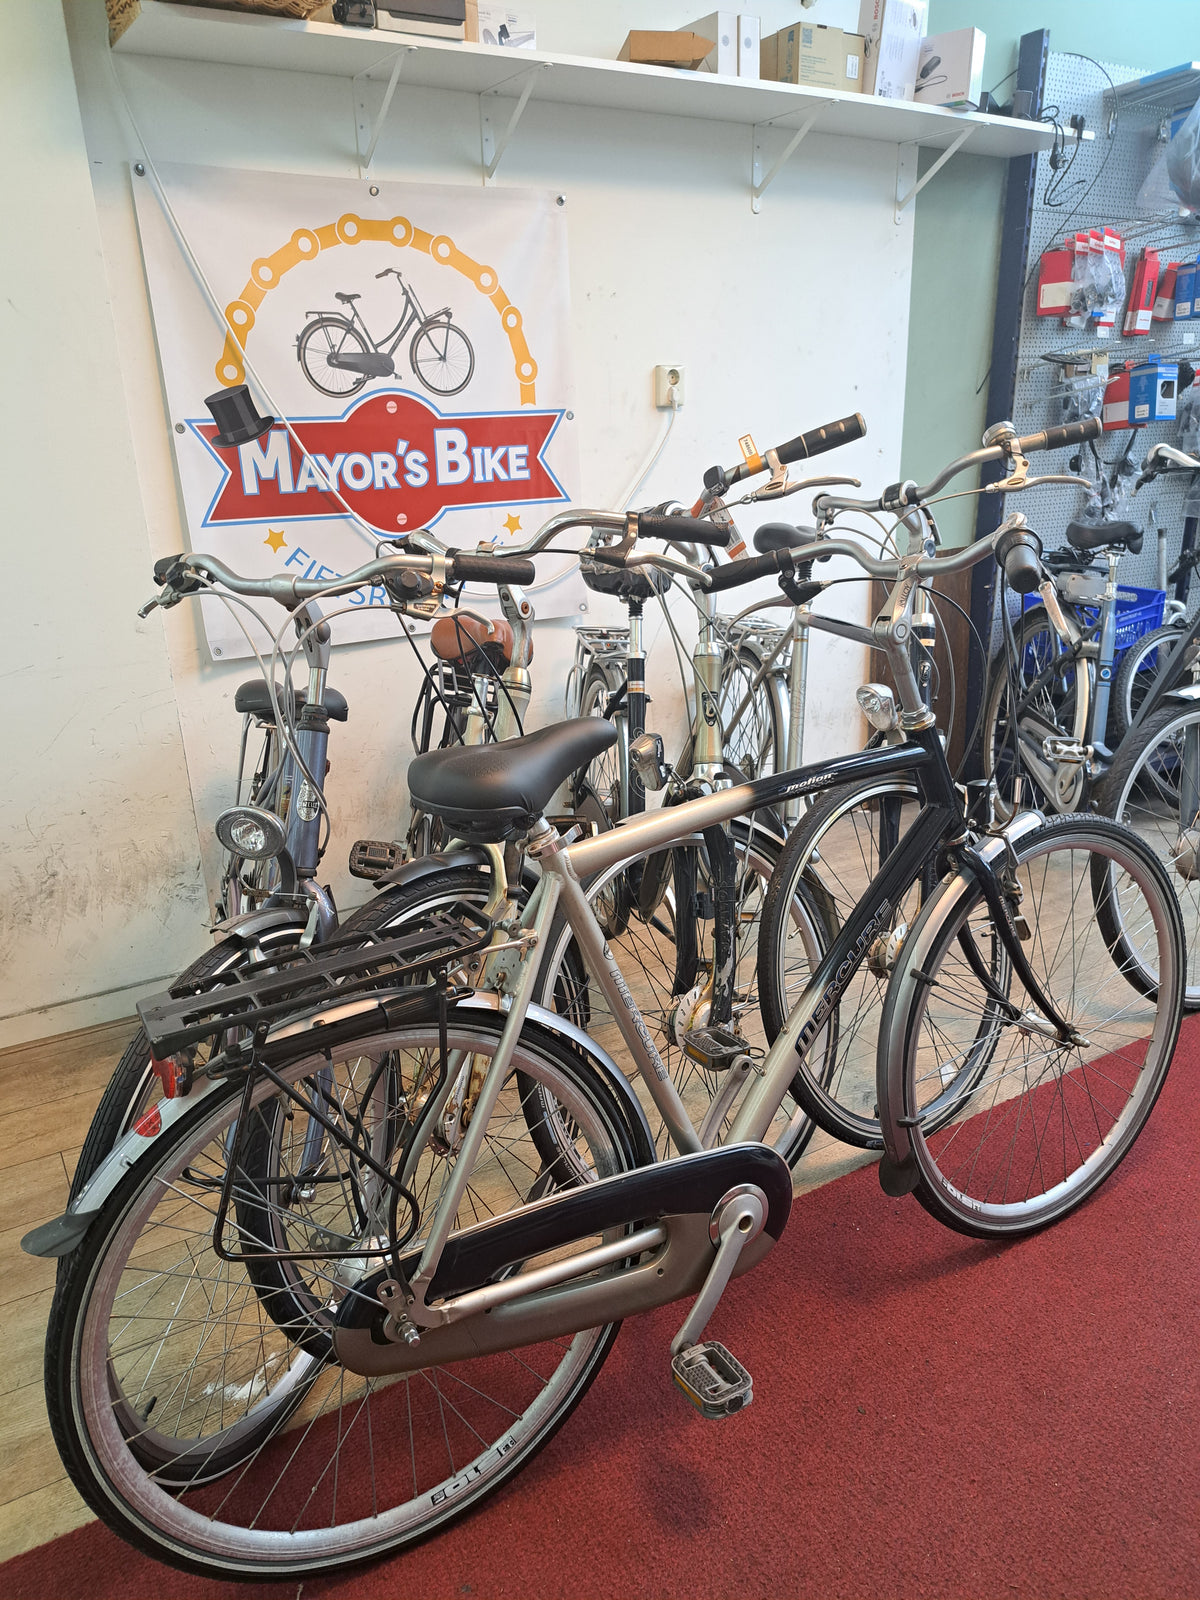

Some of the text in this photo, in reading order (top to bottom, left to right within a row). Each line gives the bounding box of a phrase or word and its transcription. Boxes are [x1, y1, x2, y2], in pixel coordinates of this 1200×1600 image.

[873, 0, 881, 20] BOSC
[237, 427, 532, 496] MAYOR'S BIKE
[795, 898, 893, 1058] MERCURE
[609, 968, 669, 1082] MERCURE
